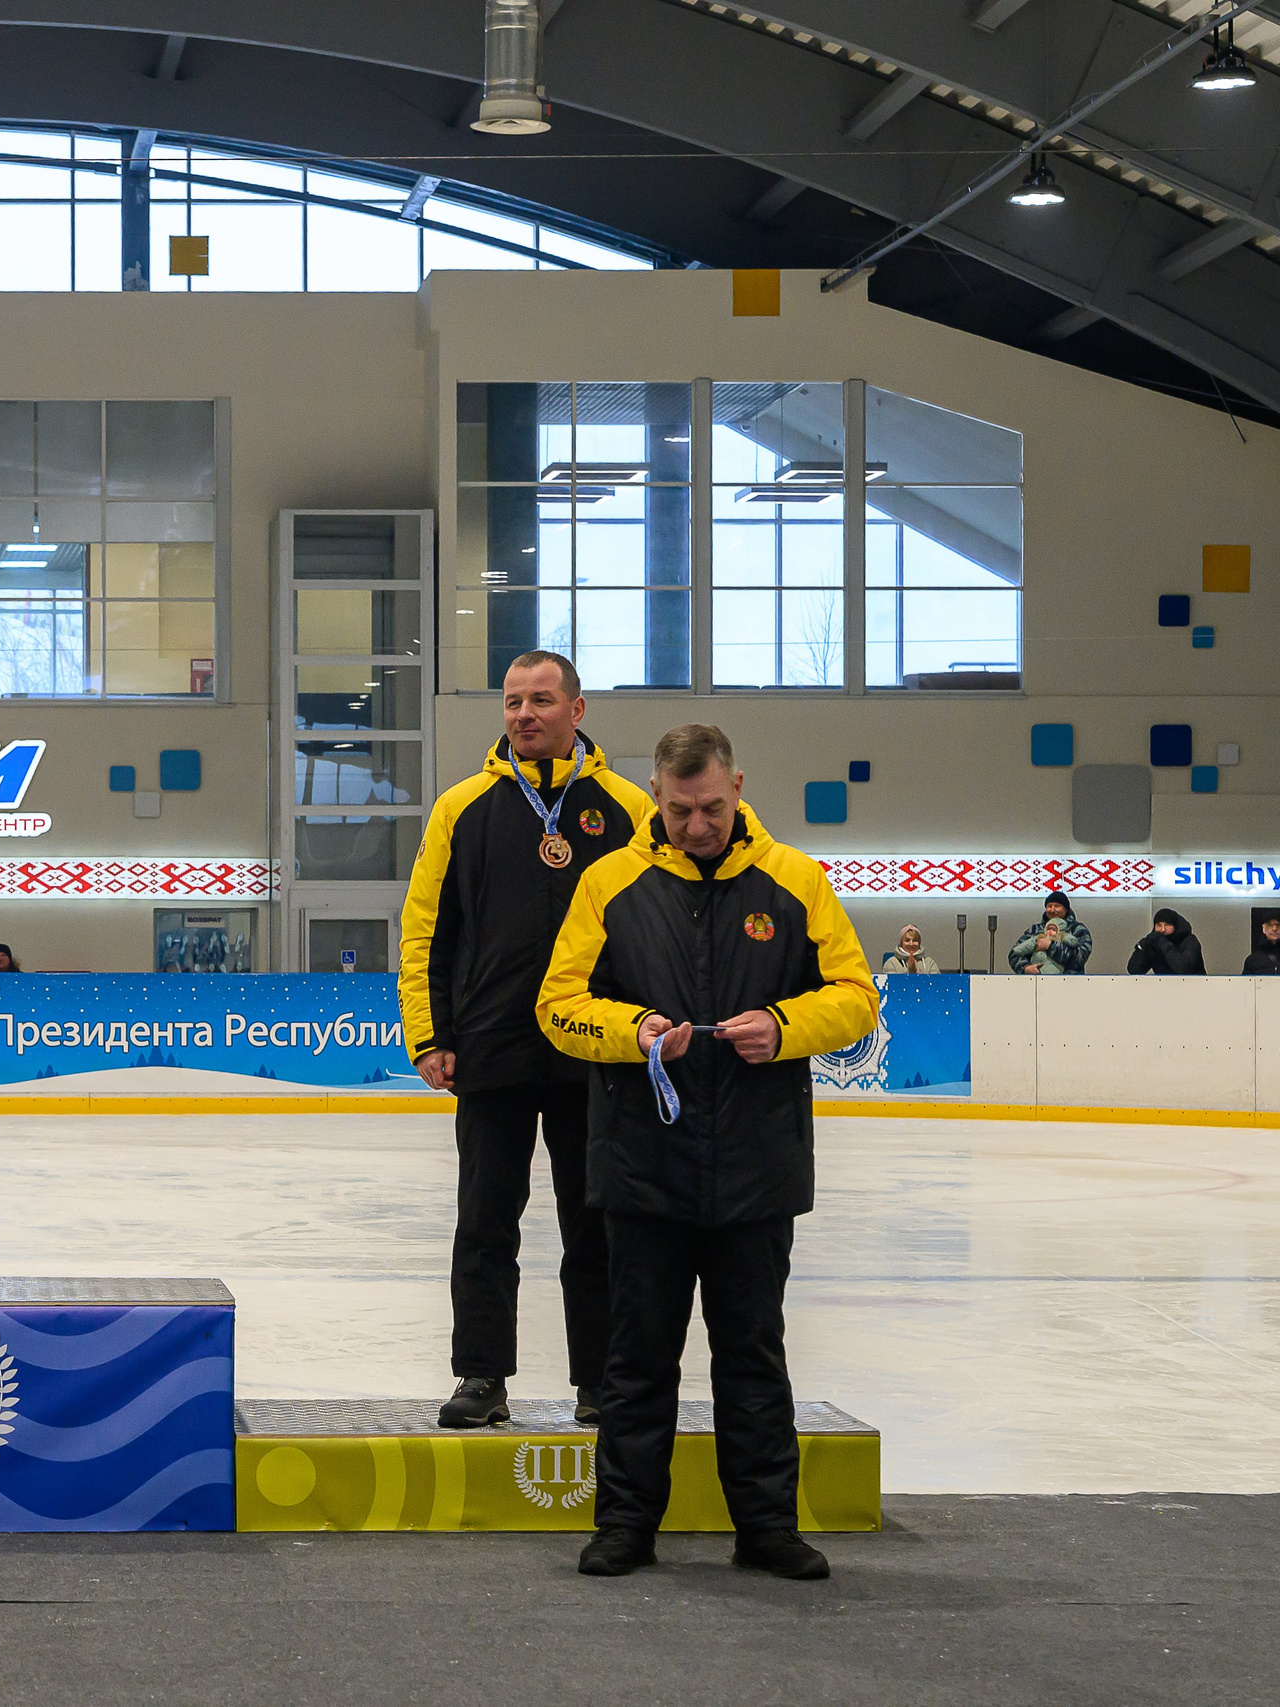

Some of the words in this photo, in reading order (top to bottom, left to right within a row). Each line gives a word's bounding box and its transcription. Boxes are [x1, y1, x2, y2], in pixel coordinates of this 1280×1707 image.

[1174, 861, 1280, 890] silichy
[224, 1012, 403, 1056] Республи
[528, 1445, 587, 1483] III
